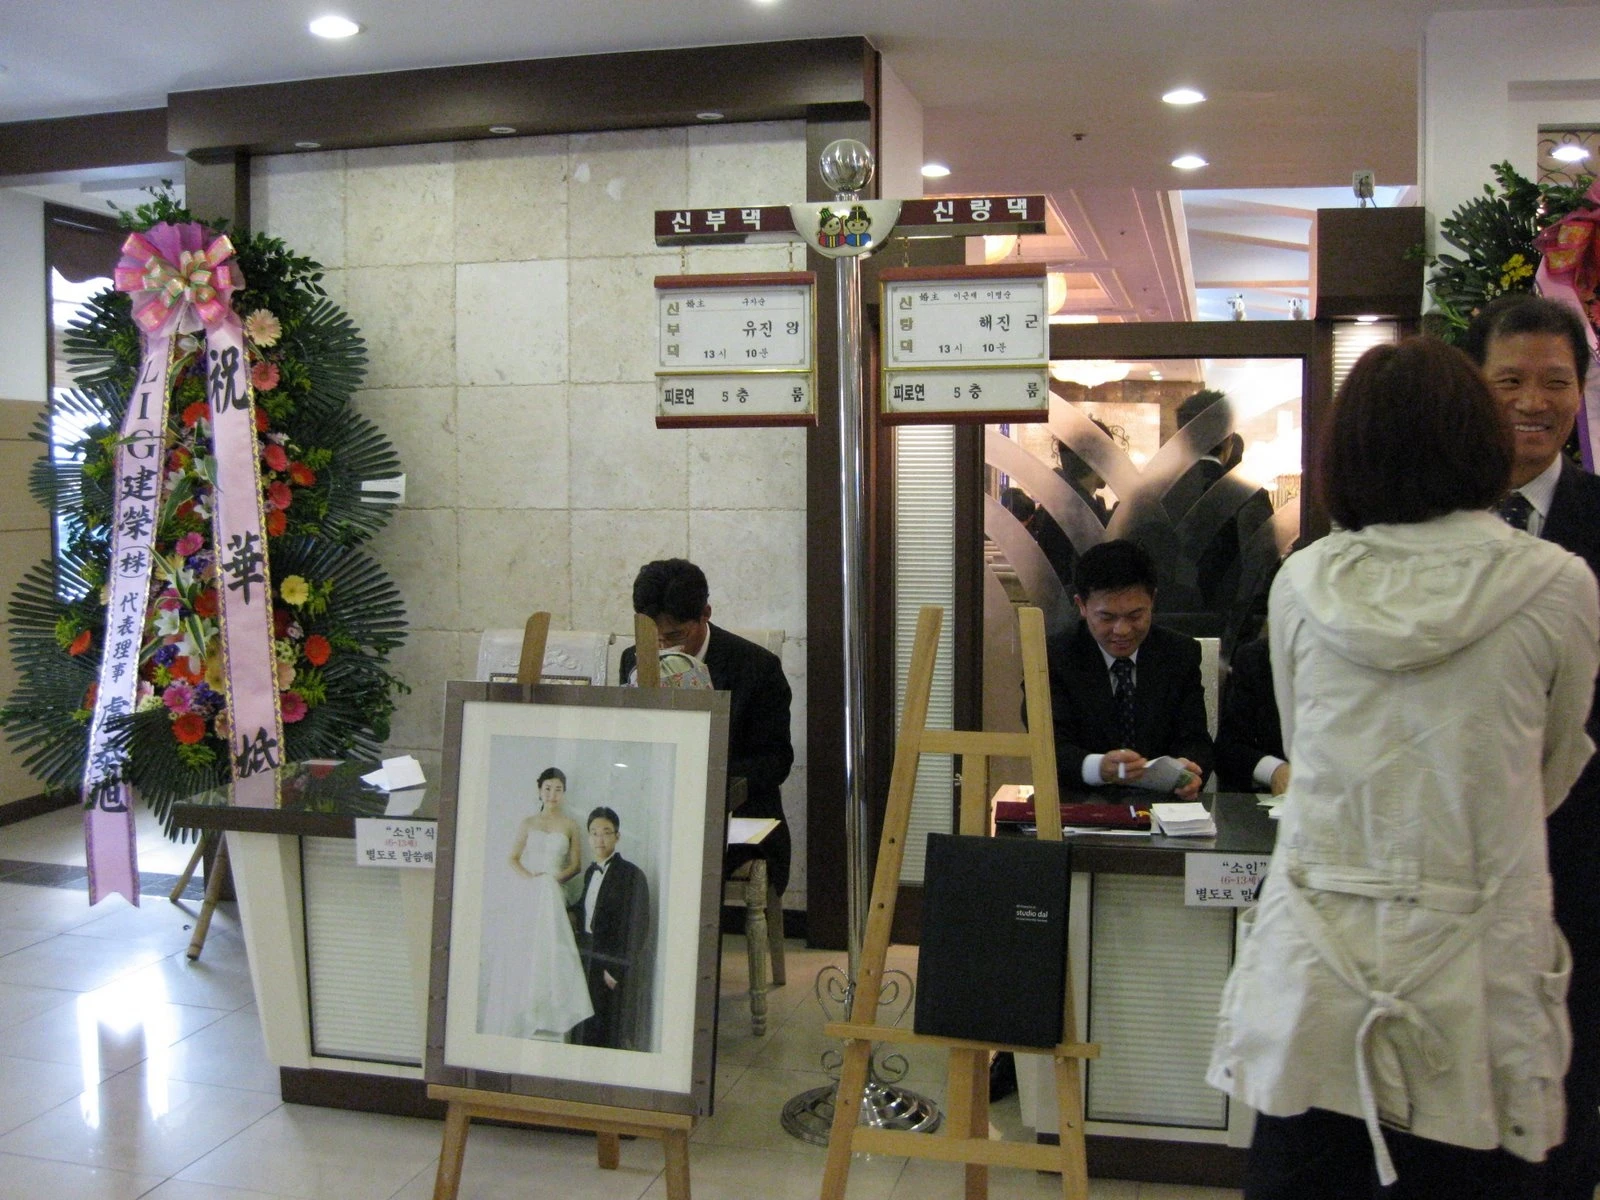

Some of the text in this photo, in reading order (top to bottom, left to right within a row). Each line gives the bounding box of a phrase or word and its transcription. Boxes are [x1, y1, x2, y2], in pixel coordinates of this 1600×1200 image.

[933, 198, 1028, 223] 신랑댁
[671, 209, 761, 233] 신부댁
[742, 320, 799, 338] 유진 양
[978, 313, 1039, 332] 해진 군
[664, 387, 695, 406] 피로연
[791, 386, 804, 403] 룸
[893, 383, 925, 402] 피로연
[1026, 382, 1040, 399] 룸
[366, 848, 434, 863] 별도로 말씀해
[1195, 887, 1235, 902] 별도로
[1016, 909, 1037, 918] studio
